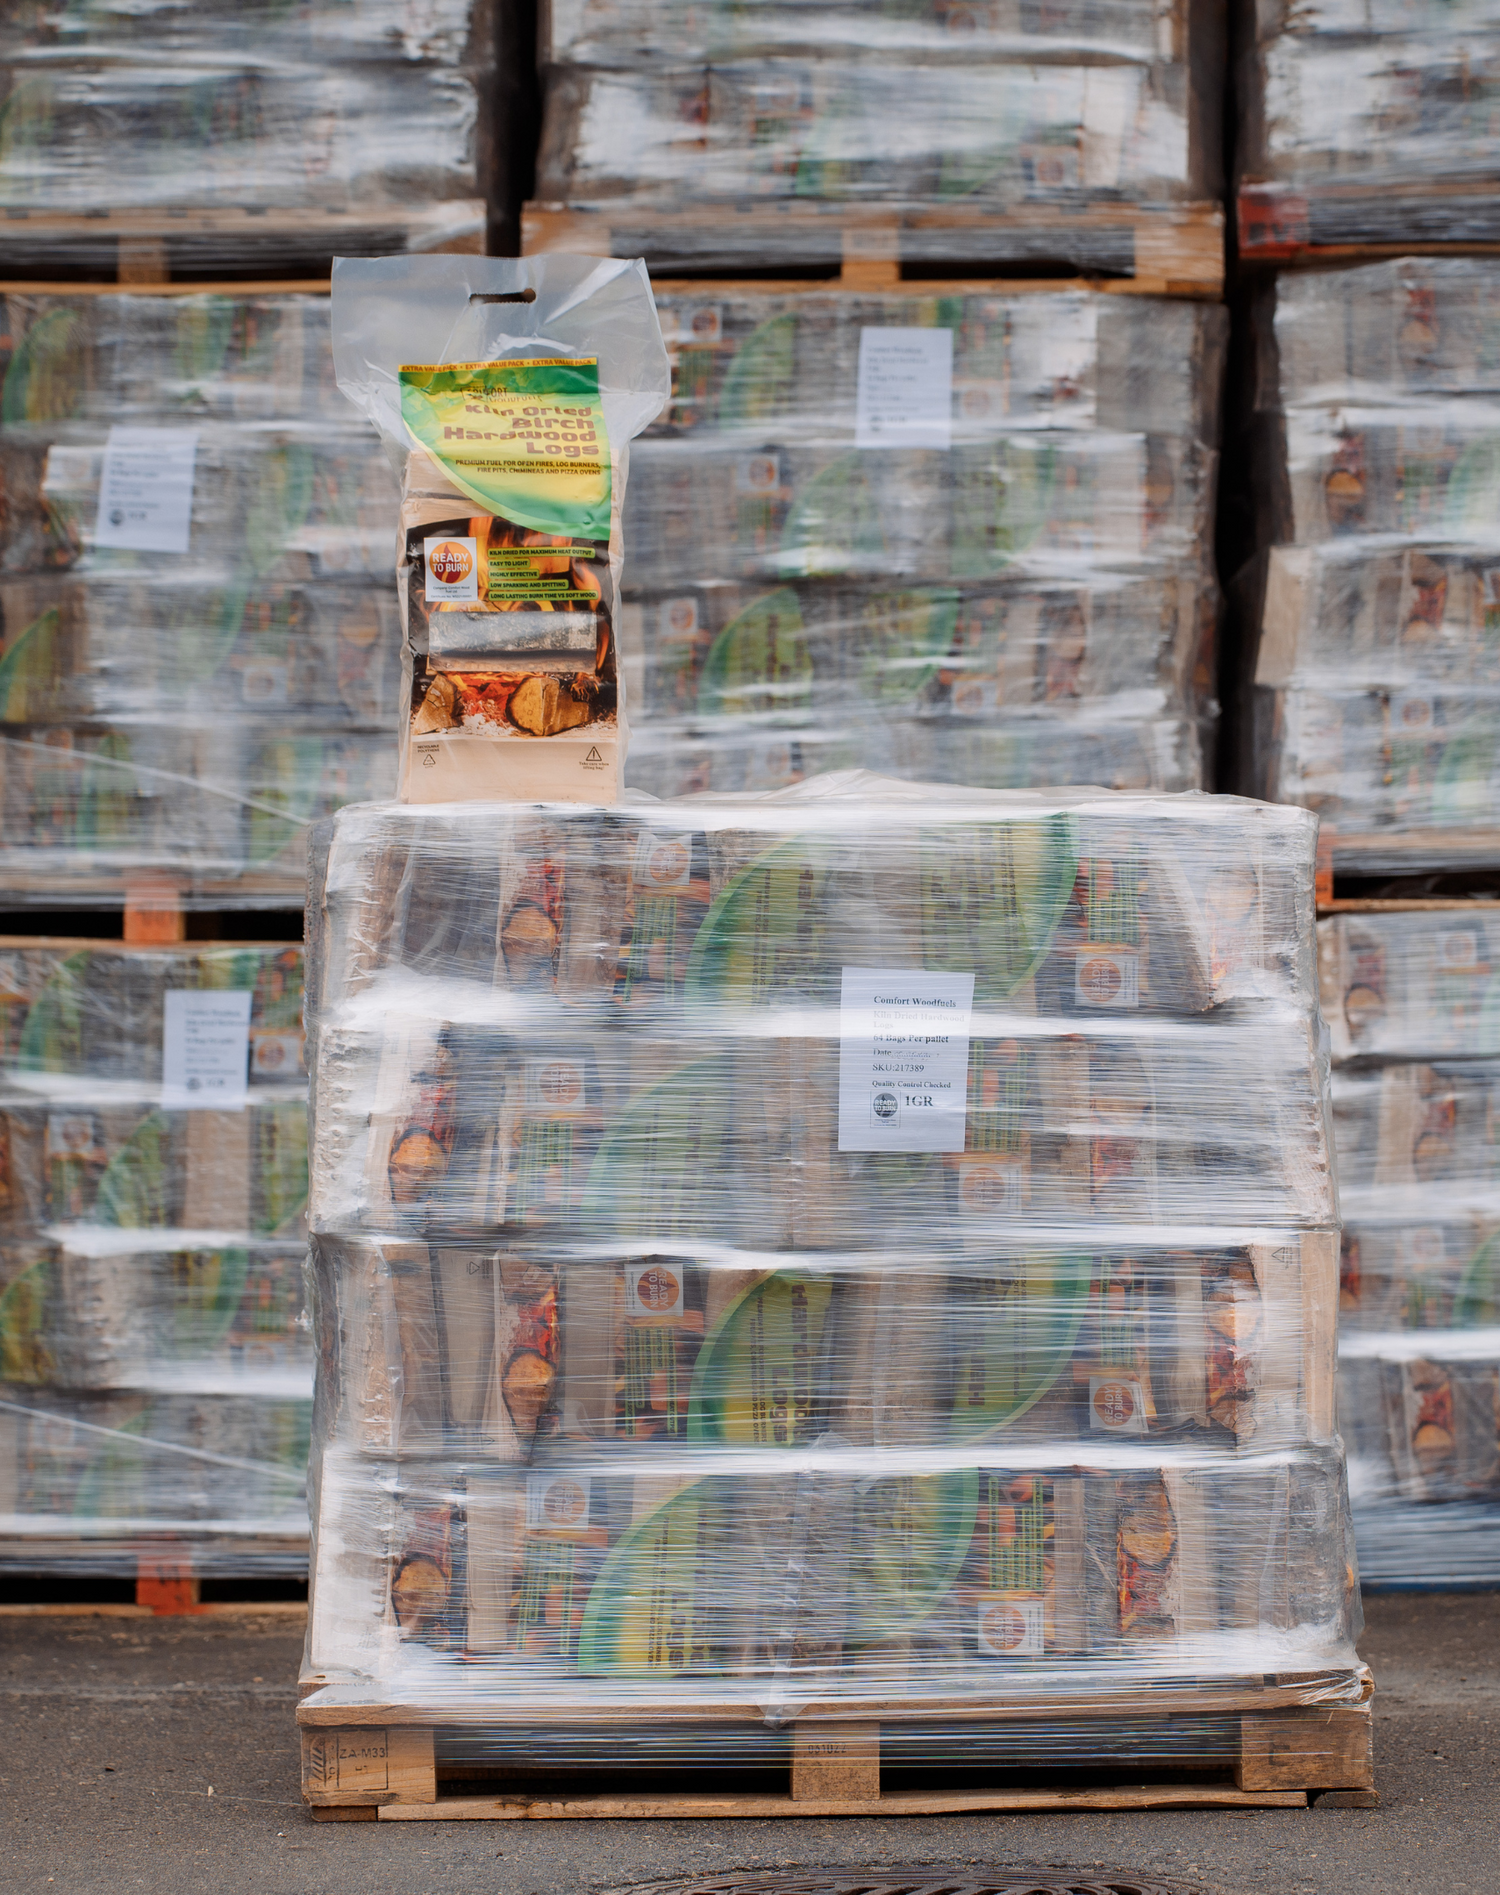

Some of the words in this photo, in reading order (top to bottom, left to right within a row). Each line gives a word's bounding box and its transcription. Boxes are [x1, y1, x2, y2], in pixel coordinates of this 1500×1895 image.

[523, 406, 592, 417] Dried
[512, 417, 595, 429] Birch
[444, 426, 597, 442] Hardwood
[526, 442, 600, 458] Logs
[432, 553, 469, 563] READY
[432, 563, 444, 573] TO
[446, 563, 469, 573] BURN
[873, 995, 910, 1005] Comfort
[912, 997, 957, 1008] Woodfuels
[873, 1011, 892, 1019] Kiln
[894, 1011, 918, 1020] Dried
[920, 1013, 965, 1022] Hardwood
[873, 1021, 894, 1029] Logs
[873, 1034, 883, 1042] 64
[886, 1034, 906, 1044] Bags
[909, 1034, 922, 1042] Per
[925, 1035, 949, 1044] pallet
[872, 1064, 925, 1072] SKU:217389
[872, 1080, 896, 1089] Quality
[924, 1081, 951, 1089] Checked
[905, 1095, 934, 1107] 1GR
[648, 1271, 658, 1283] TO
[657, 1270, 670, 1308] READY
[650, 1284, 659, 1309] BURN
[1104, 1386, 1114, 1423] READY
[1114, 1387, 1123, 1410] BURN
[769, 1368, 789, 1443] Logs
[1113, 1411, 1123, 1424] TO
[666, 1592, 689, 1669] Logs
[339, 1747, 386, 1759] ZA-M33
